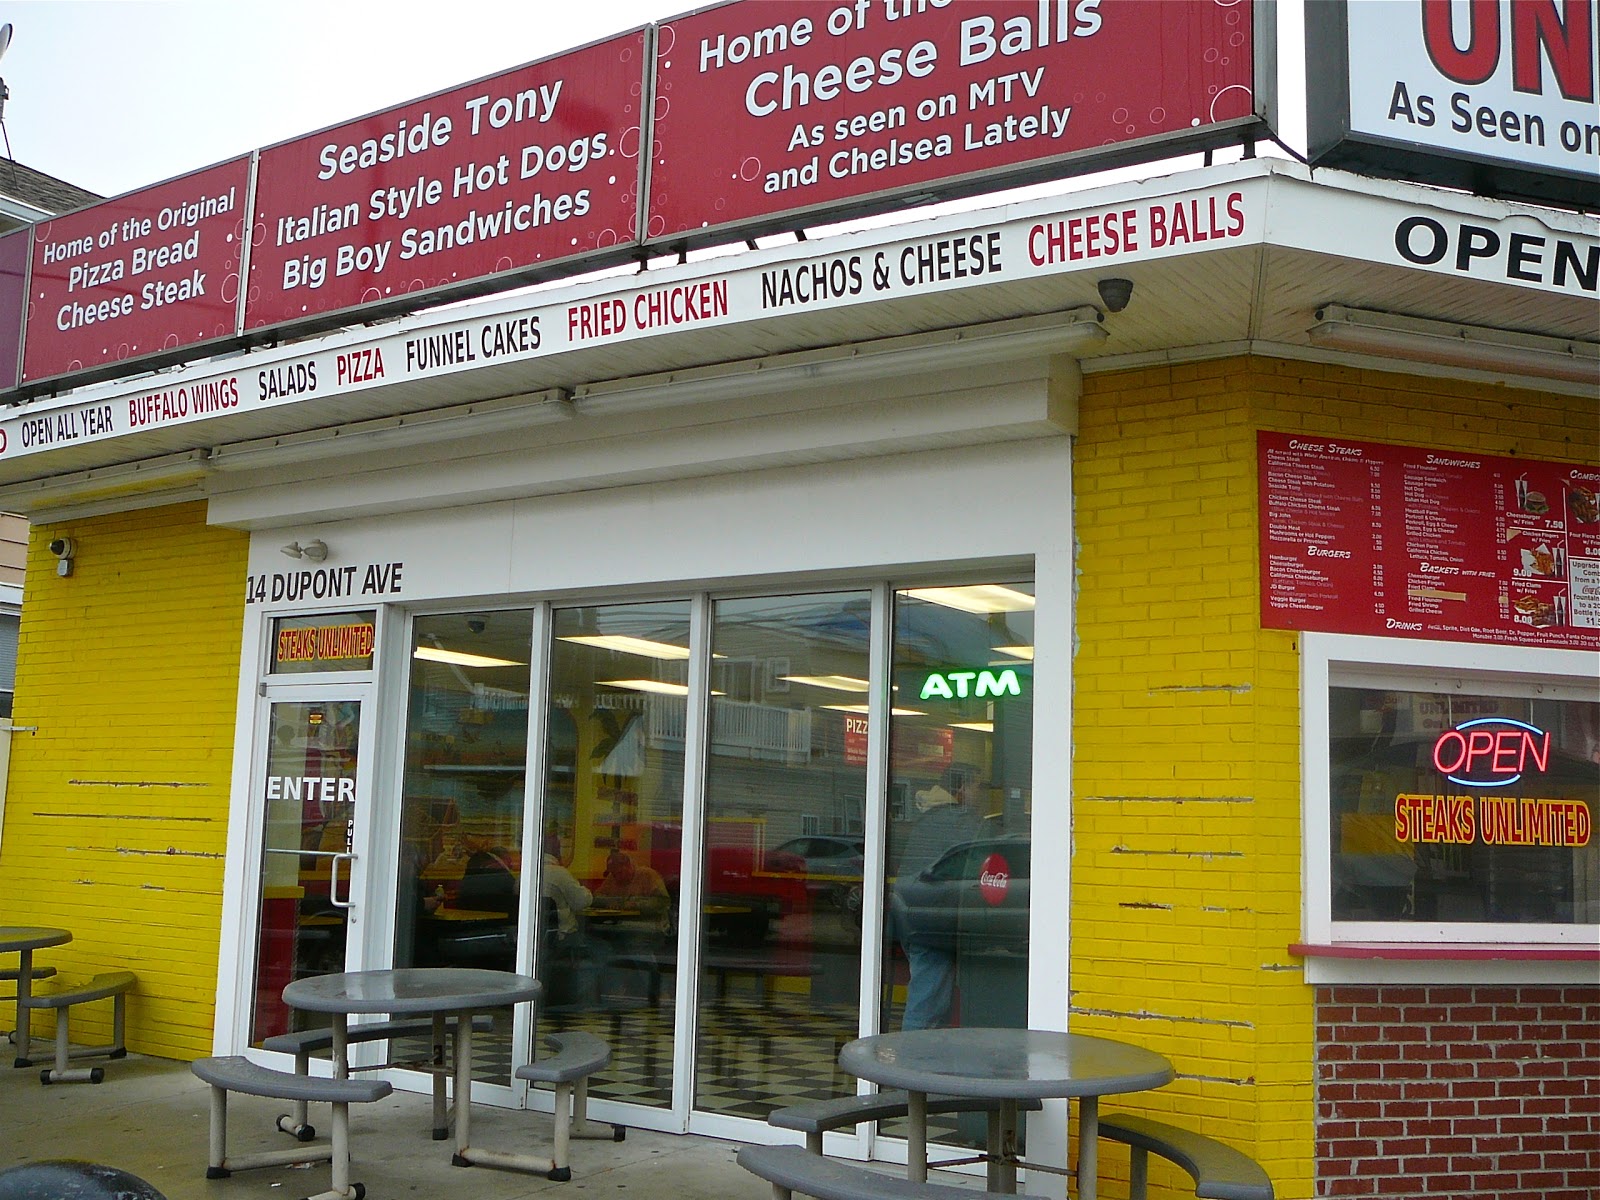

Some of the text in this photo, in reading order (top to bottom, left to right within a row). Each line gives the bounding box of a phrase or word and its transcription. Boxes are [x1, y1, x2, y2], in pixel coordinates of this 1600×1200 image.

[699, 16, 814, 73] Home
[826, 0, 872, 36] of
[744, 0, 1102, 117] Cheese Balls
[1421, 0, 1600, 104] UN
[317, 80, 564, 182] Seaside Tony
[786, 66, 1045, 152] As seen on MTV
[1388, 81, 1436, 127] As
[1450, 92, 1544, 146] Seen
[763, 106, 1072, 194] and Chelsea Lately
[43, 187, 236, 266] Home of the Original
[275, 202, 360, 248] Italian
[367, 176, 444, 221] Style
[452, 154, 510, 198] Hot
[1028, 192, 1244, 266] CHEESE BALLS
[67, 230, 200, 293] Pizza Bread
[282, 188, 591, 290] Big Boy Sandwiches
[761, 232, 1001, 308] NACHOS & CHEESE
[1394, 216, 1600, 292] OPEN
[56, 270, 206, 332] Cheese Steak
[568, 280, 728, 342] FRIED CHICKEN
[336, 347, 384, 386] PIZZA
[406, 316, 541, 372] FUNNEL CAKES
[129, 378, 238, 428] BUFFALO WINGS
[258, 360, 316, 402] SALADS
[22, 417, 52, 448] OPEN
[57, 412, 78, 441] ALL
[81, 406, 113, 436] YEAR
[1426, 455, 1480, 469] SANDWICHES
[246, 562, 403, 604] 14 DUPONT AVE
[1308, 546, 1351, 558] BURGERS
[277, 623, 374, 662] STEAKS UNLIMITED
[1385, 618, 1422, 631] DRINKS
[920, 670, 1020, 700] ATM
[846, 718, 868, 734] PIZZ
[1433, 731, 1550, 773] OPEN
[266, 776, 356, 802] ENTER
[1395, 794, 1591, 847] STEAKS UNLIMITED
